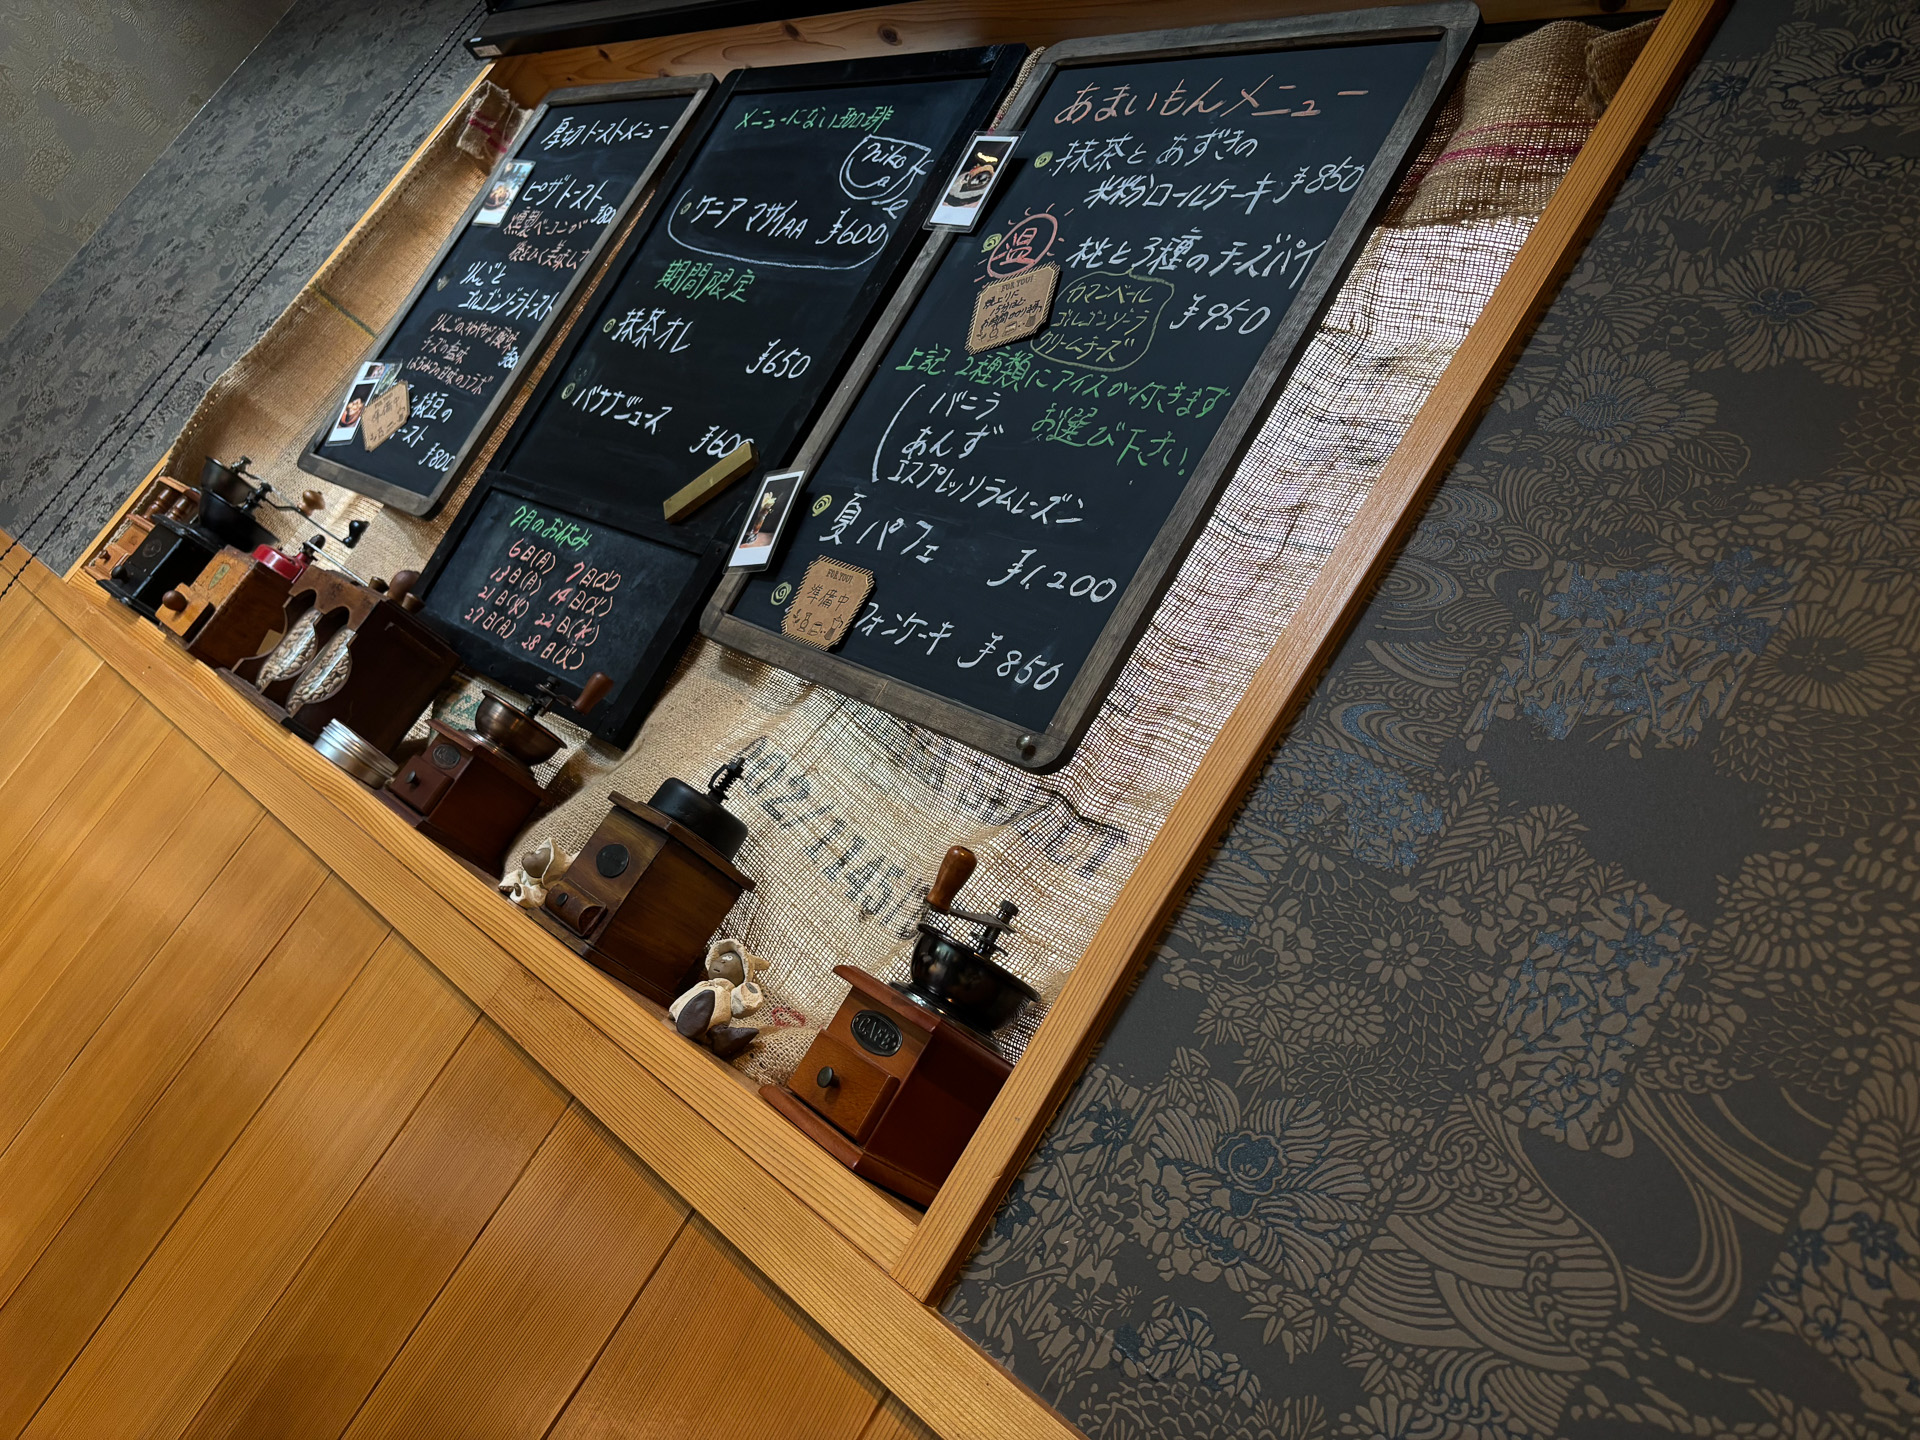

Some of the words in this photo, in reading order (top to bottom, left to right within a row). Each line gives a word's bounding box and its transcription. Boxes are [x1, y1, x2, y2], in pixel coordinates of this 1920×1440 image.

[1054, 75, 1369, 124] あまいもんメニュー
[540, 116, 671, 151] 厚切トーストメニュー
[734, 105, 895, 134] メニューにない珈琲
[862, 142, 907, 169] niko
[1050, 128, 1259, 175] 抹茶とあずきの
[522, 174, 609, 211] ピザトースト
[1083, 172, 1276, 215] 米粉ロールケーキ
[815, 207, 886, 245] ¥600
[992, 227, 1037, 266] 温
[460, 261, 507, 286] りんごと
[655, 259, 756, 303] 期間限定
[1067, 282, 1154, 304] カマンベール
[611, 308, 694, 353] 抹茶オレ
[1050, 308, 1151, 332] ゴルゴンゾーラ
[1169, 295, 1270, 335] ¥950
[746, 339, 812, 379] ¥650
[1035, 332, 1135, 363] クリームチーズ
[572, 384, 673, 435] バナナジュース
[930, 390, 1001, 420] バニラ
[901, 424, 1004, 460] あんず
[888, 460, 1083, 526] エスプレッソラムレーズン
[510, 505, 593, 551] 7月のお休み
[819, 493, 940, 564] 夏パフェ
[807, 584, 849, 611] 準備中
[854, 602, 954, 656] フォンケーキ
[957, 633, 1065, 691] ¥850
